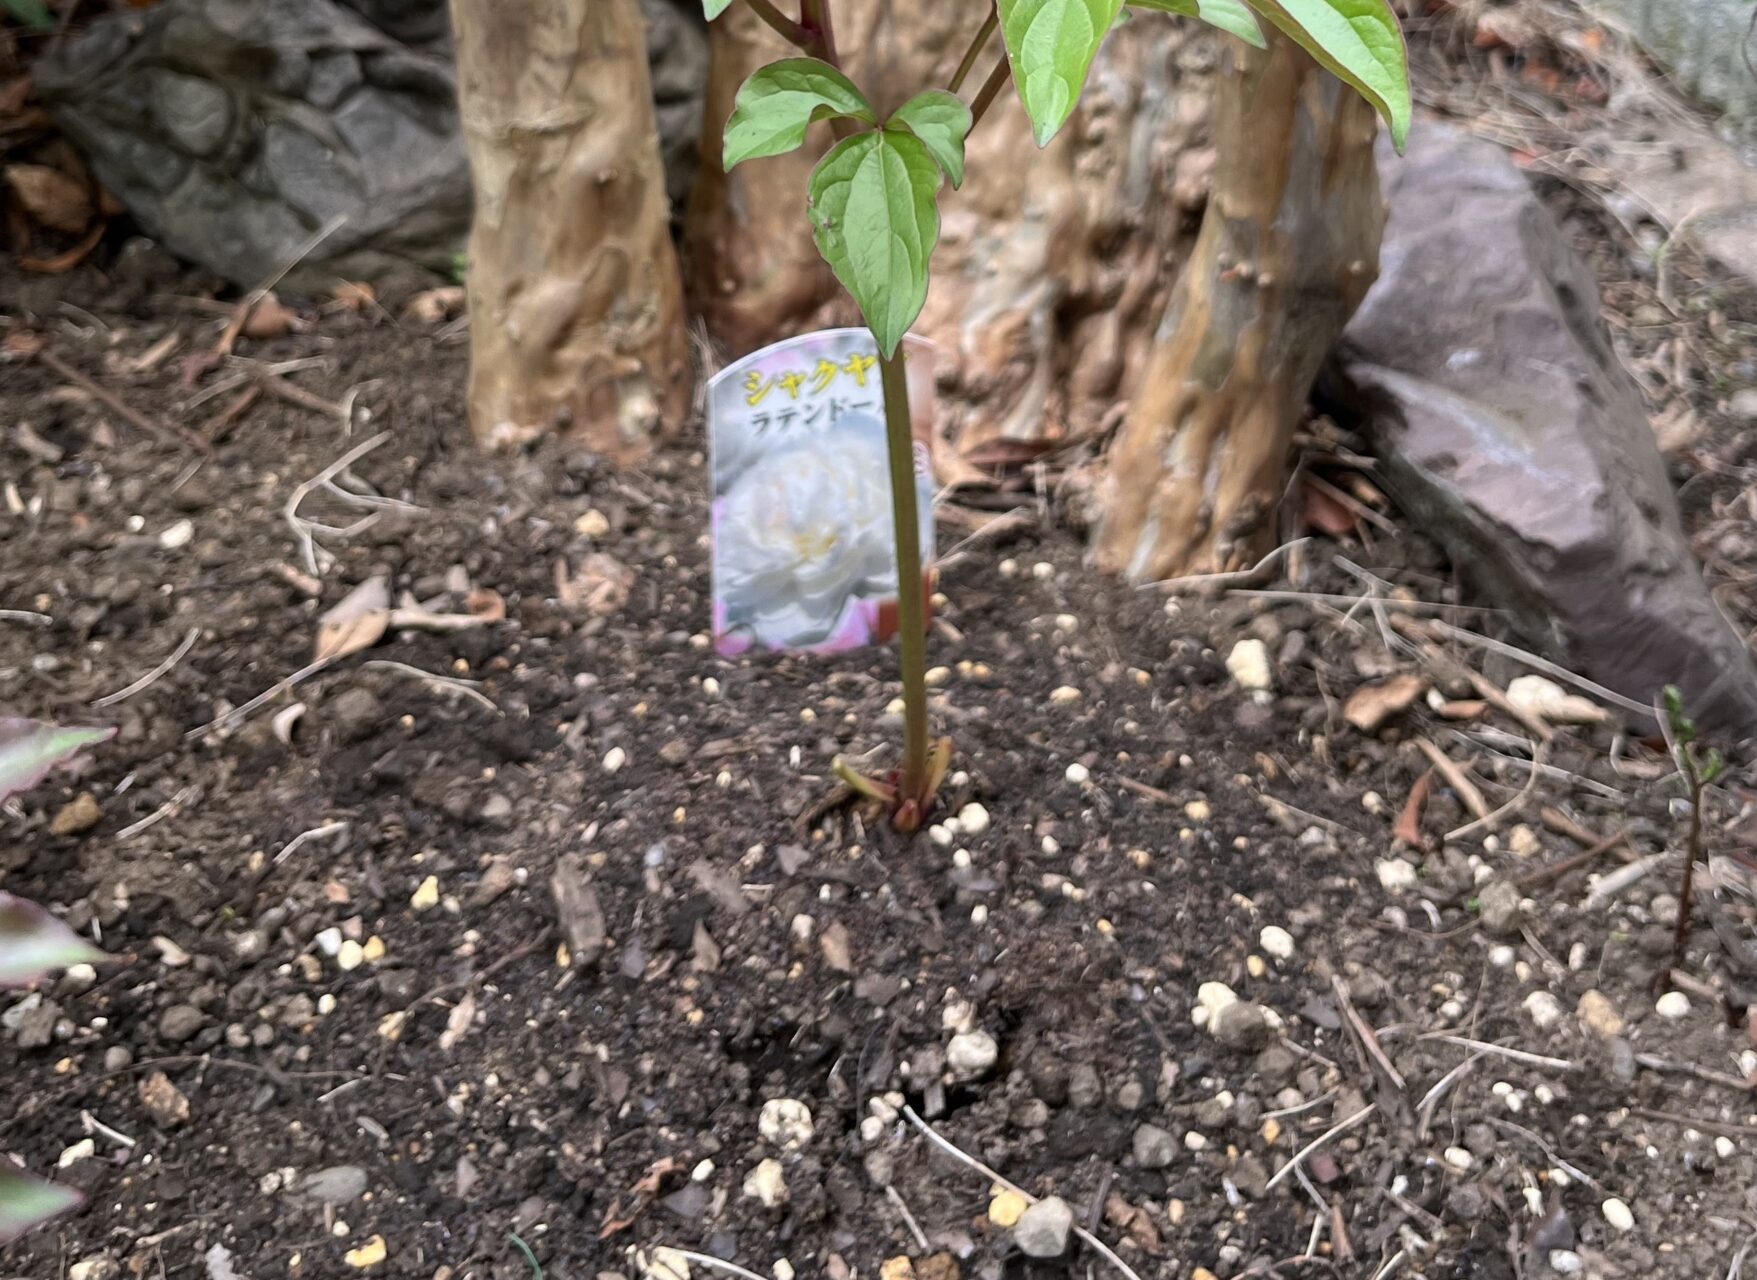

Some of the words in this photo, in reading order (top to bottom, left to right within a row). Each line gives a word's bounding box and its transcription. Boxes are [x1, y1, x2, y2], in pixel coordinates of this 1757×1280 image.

[744, 353, 909, 406] シャクヤ
[752, 396, 885, 434] ラテンドー
